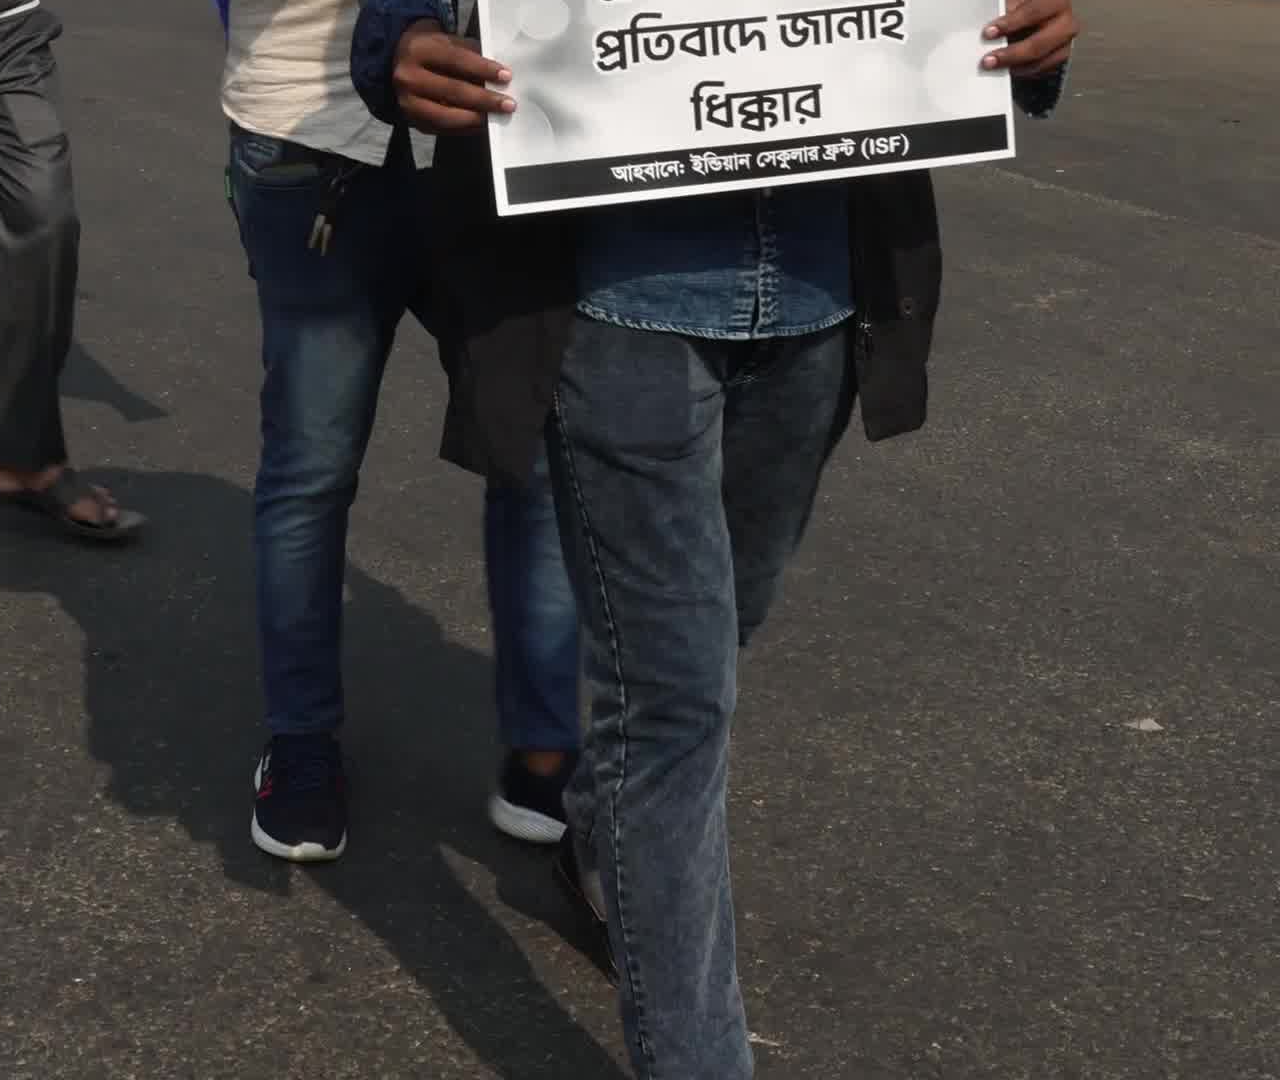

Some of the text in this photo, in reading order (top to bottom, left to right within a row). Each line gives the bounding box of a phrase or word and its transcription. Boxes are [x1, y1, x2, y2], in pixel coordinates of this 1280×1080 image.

[595, 12, 768, 71] প্রতিবাদে
[691, 81, 823, 132] ধিক্কার
[756, 144, 819, 169] সেকুলার
[860, 133, 910, 160] (ISF)
